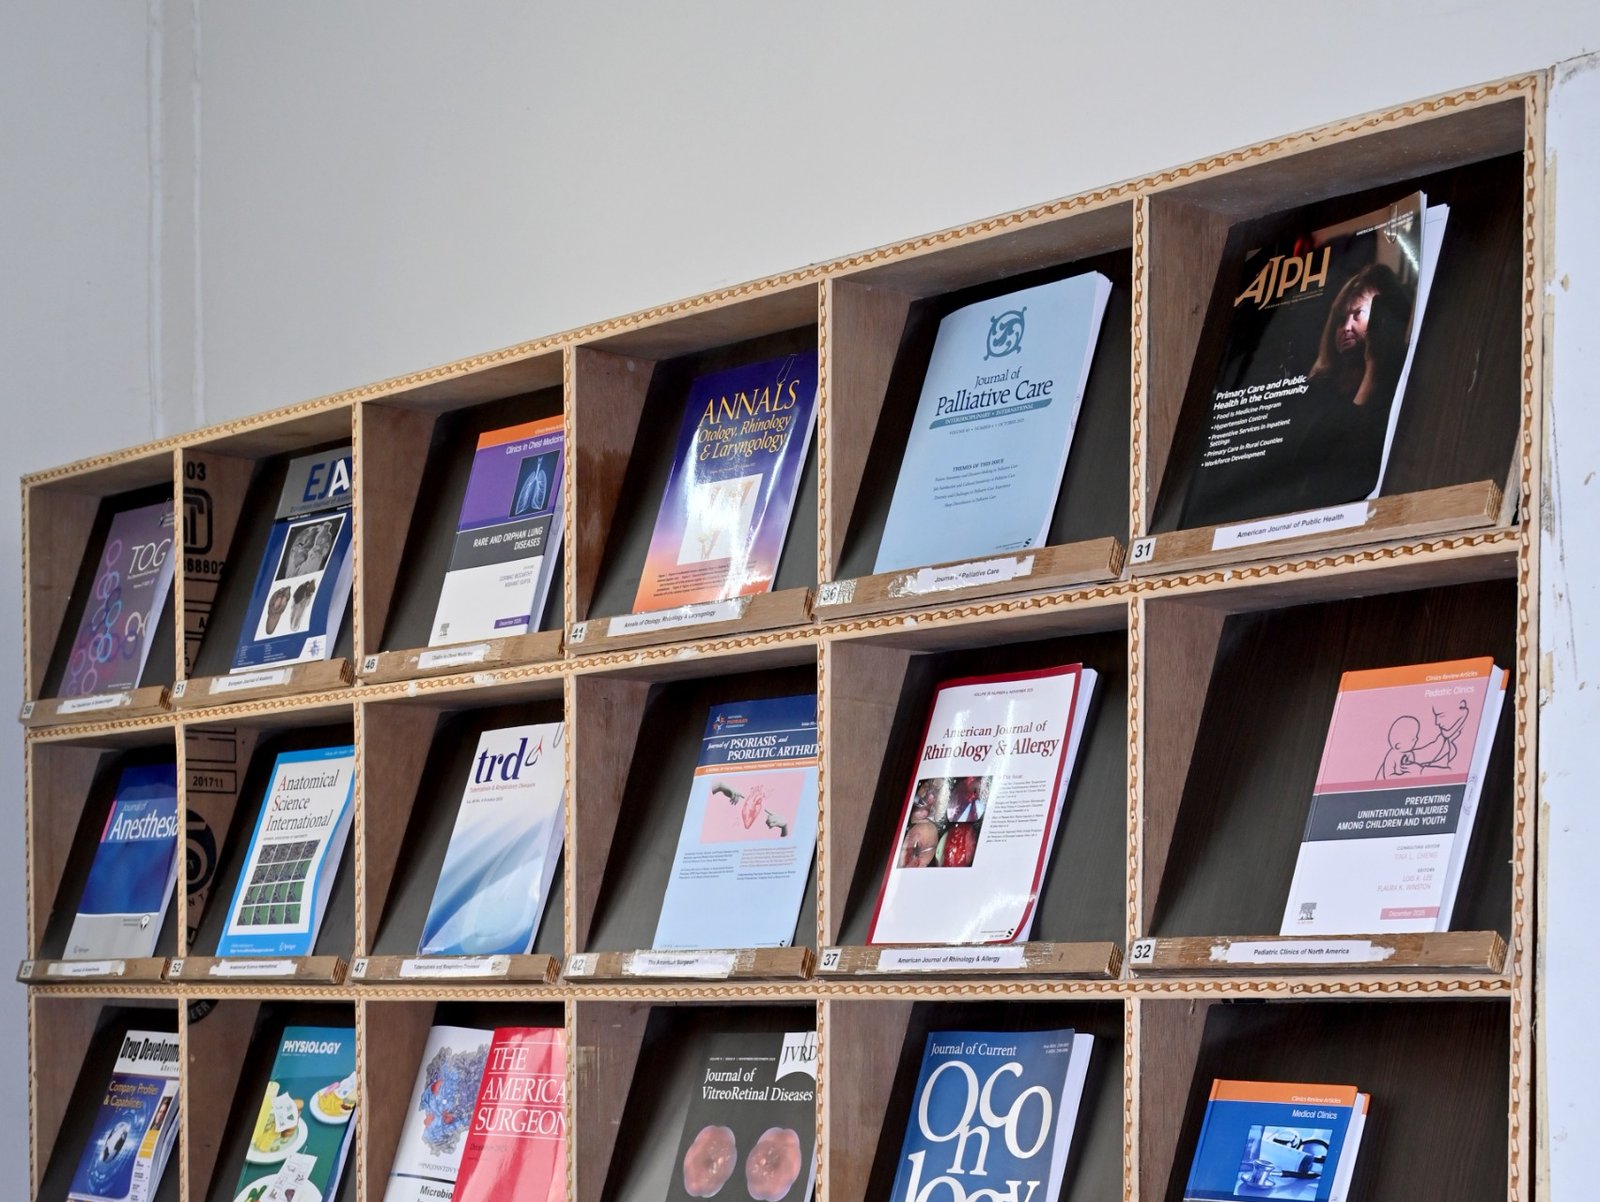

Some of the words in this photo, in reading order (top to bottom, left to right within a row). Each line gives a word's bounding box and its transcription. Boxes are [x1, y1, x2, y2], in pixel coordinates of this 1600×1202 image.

[1234, 246, 1332, 310] AJPH
[974, 370, 1010, 389] Journal
[1011, 366, 1022, 380] of
[698, 380, 800, 428] ANNALS
[936, 386, 1010, 416] Palliative
[1016, 378, 1054, 400] Care
[698, 425, 738, 444] Otology,
[742, 414, 792, 434] Rhinology
[506, 444, 522, 455] Clinics
[523, 442, 528, 451] in
[529, 440, 542, 450] Chest
[474, 537, 488, 548] RARE
[490, 534, 502, 545] AND
[504, 530, 527, 544] ORPHAN
[528, 526, 543, 538] LUNG
[514, 538, 541, 550] DISEASES
[129, 538, 171, 574] TOG
[1134, 542, 1152, 558] 31
[364, 659, 376, 670] 46
[175, 684, 185, 695] 51
[942, 726, 992, 739] American
[992, 723, 1032, 738] Journal
[1035, 720, 1048, 733] of
[922, 740, 992, 762] Rhinology
[995, 740, 1007, 756] &
[1010, 738, 1060, 760] Allergy
[474, 738, 528, 784] trd
[192, 776, 224, 789] 201711
[277, 770, 340, 792] Anatomical
[272, 795, 310, 812] Science
[1404, 794, 1451, 806] PREVENTING
[1358, 808, 1414, 819] UNINTENTIONAL
[1415, 805, 1448, 816] INJURIES
[266, 810, 333, 832] International
[1336, 820, 1364, 832] AMONG
[1366, 818, 1402, 830] CHILDREN
[1404, 817, 1420, 827] AND
[1422, 816, 1446, 826] YOUTH
[1134, 944, 1151, 959] 32
[172, 962, 182, 973] 52
[354, 962, 365, 974] 47
[824, 954, 838, 966] 37
[897, 956, 920, 964] American
[922, 956, 941, 964] Journal
[949, 956, 975, 964] Rhinology
[980, 956, 1000, 964] Allergy
[282, 1040, 342, 1055] PHYSIOLOGY
[931, 1042, 964, 1056] Journal
[966, 1042, 976, 1056] of
[978, 1042, 1016, 1057] Current
[491, 1048, 530, 1071] THE
[704, 1068, 742, 1084] Journal
[744, 1067, 757, 1082] of
[482, 1077, 565, 1103] AMERICA
[702, 1086, 769, 1100] VitreoRetinal
[770, 1087, 814, 1102] Diseases
[475, 1108, 565, 1136] SURGEON
[1292, 1109, 1316, 1118] Medical
[1316, 1110, 1338, 1120] Clinics
[420, 1185, 453, 1200] Microbio
